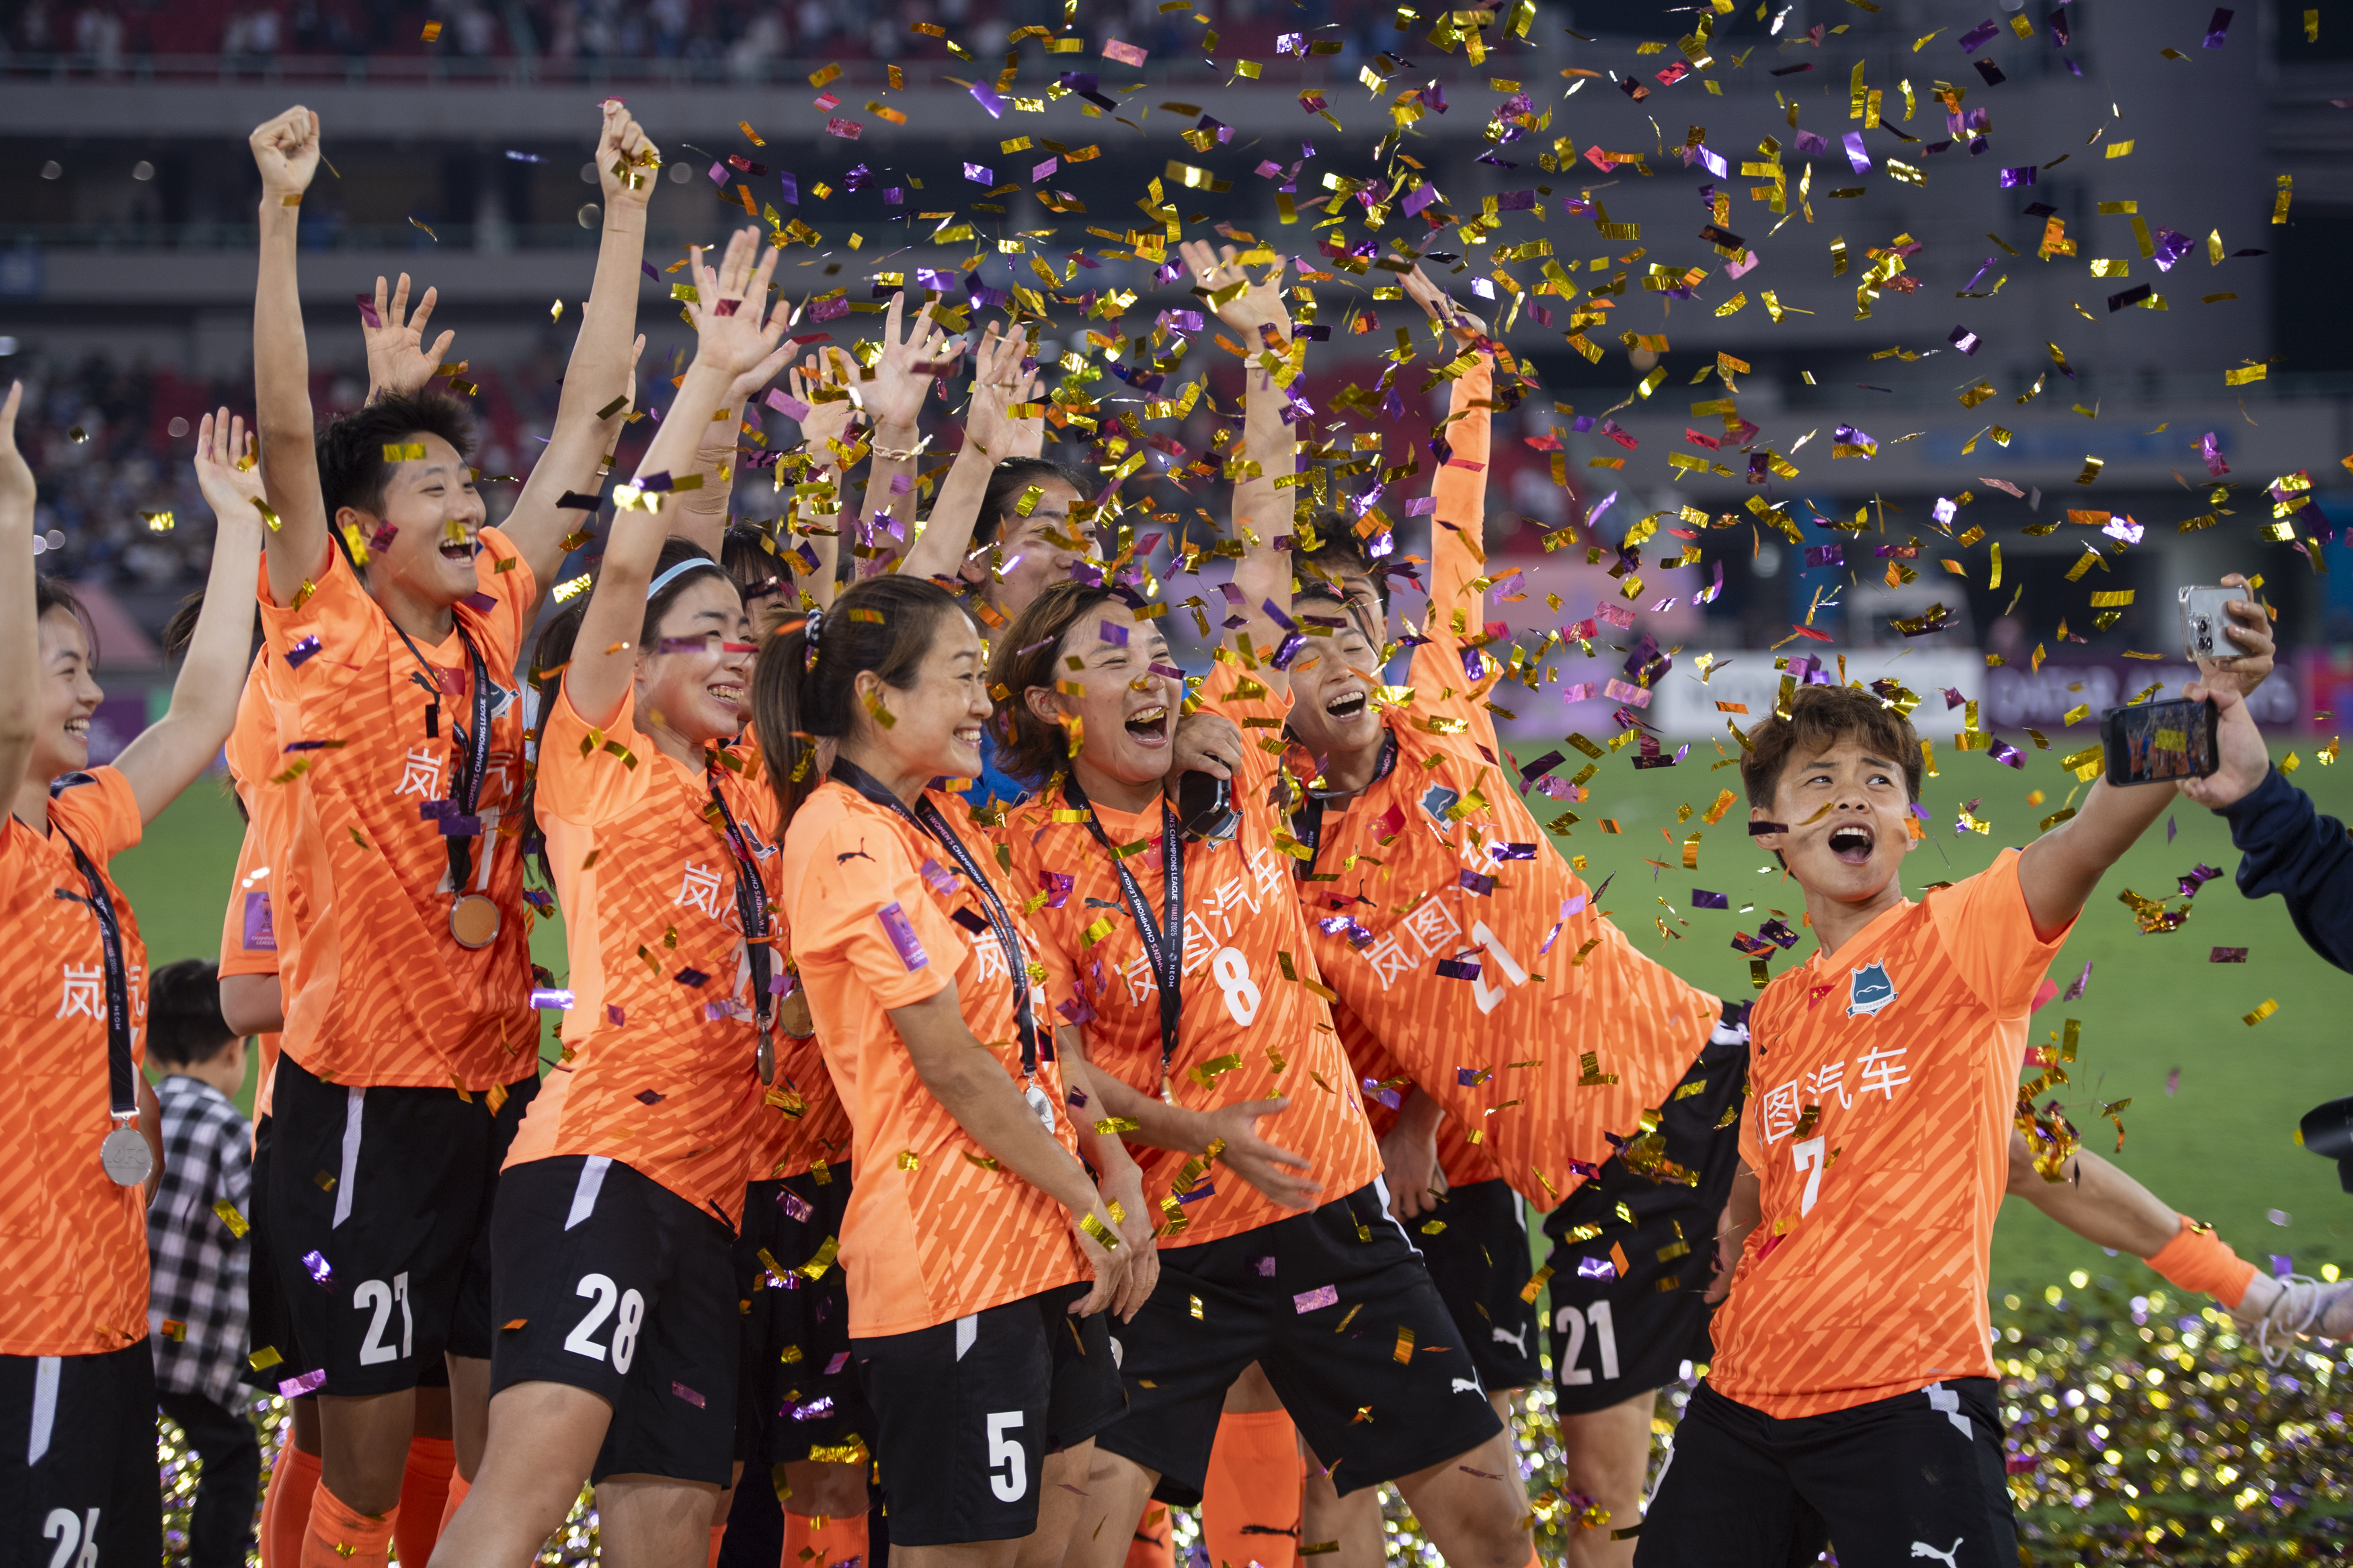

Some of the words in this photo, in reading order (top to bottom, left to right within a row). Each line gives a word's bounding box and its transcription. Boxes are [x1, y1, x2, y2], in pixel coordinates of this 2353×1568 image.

[467, 773, 479, 810] WOMEN'S
[475, 725, 487, 773] CHAMPIONS
[929, 815, 955, 845] WOMEN'S
[952, 845, 982, 883] CHAMPIONS
[980, 883, 1001, 908] LEAGUE
[1122, 871, 1138, 898] LEAGUE
[1169, 829, 1177, 871] CHAMPIONS
[1133, 898, 1156, 943] CHAMPIONS
[1213, 947, 1262, 1026] 8
[1755, 1046, 1911, 1145] 图汽车
[1792, 1134, 1825, 1219] 7
[354, 1271, 413, 1366] 27
[564, 1274, 645, 1374] 28
[1556, 1301, 1620, 1385] 21
[987, 1411, 1027, 1503] 5
